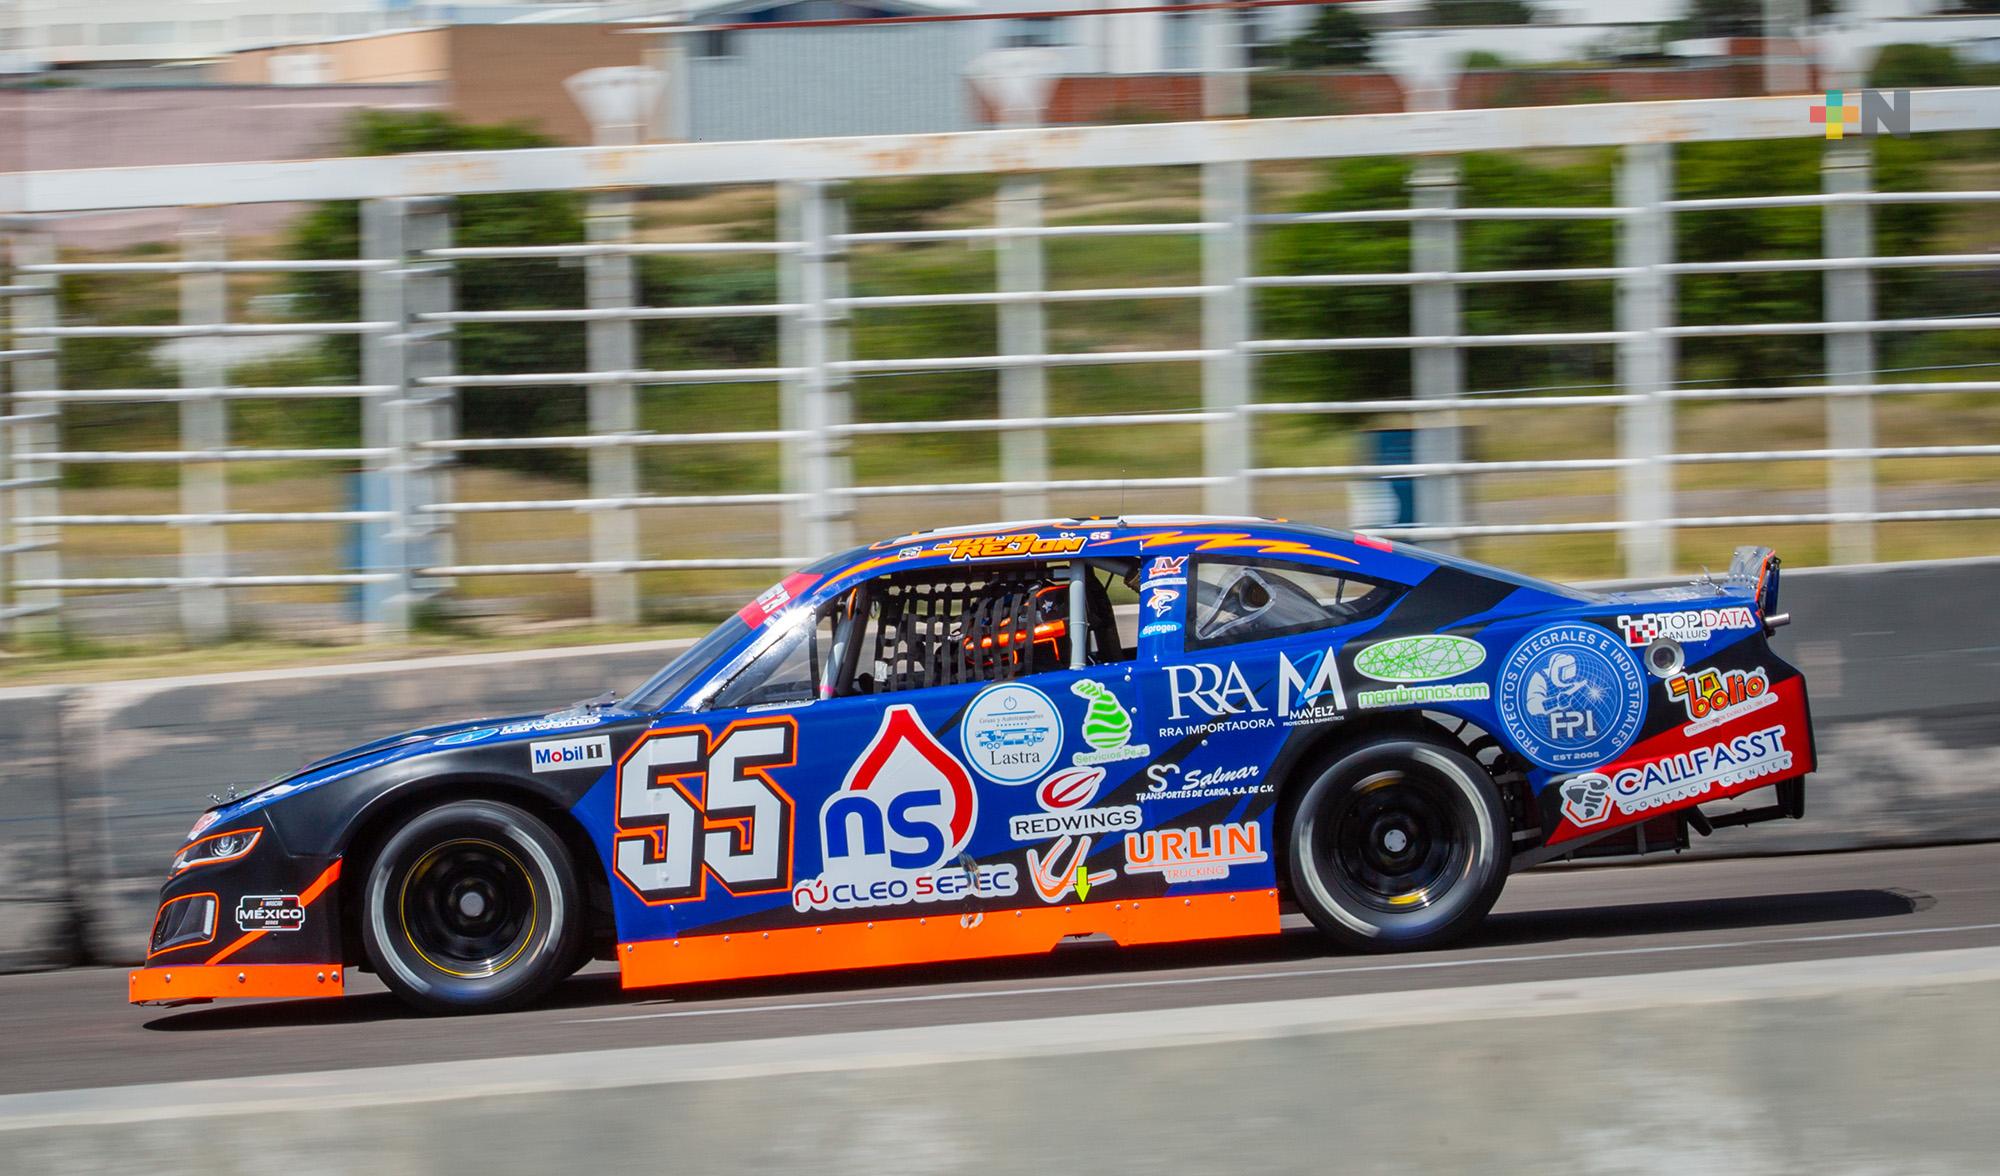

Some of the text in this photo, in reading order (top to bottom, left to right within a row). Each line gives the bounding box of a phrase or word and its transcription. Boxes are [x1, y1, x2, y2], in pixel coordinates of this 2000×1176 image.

[952, 537, 1086, 559] REJON
[1660, 610, 1752, 630] TOP DATA
[1600, 639, 1610, 651] E
[1686, 629, 1708, 639] LUIS
[1513, 631, 1596, 669] INTEGRALES
[1161, 660, 1269, 720] RRA
[1360, 685, 1487, 705] membranas.com
[1610, 648, 1640, 747] INDUSTRIALES
[1687, 672, 1765, 718] bolio
[1289, 705, 1335, 720] MAVELZ
[1503, 673, 1540, 755] PROYECTOS
[1159, 717, 1275, 737] RRA IMPORTADORA
[1550, 710, 1598, 739] FPI
[536, 746, 583, 764] Mobil
[990, 750, 1041, 766] Lastra
[1552, 753, 1573, 762] EST
[1615, 728, 1784, 796] CALLFASST
[1182, 766, 1259, 790] Salmar
[1626, 758, 1790, 812] CONTACT CENTER
[1136, 790, 1191, 802] TRANSPORTES
[1191, 789, 1202, 798] DE
[1248, 785, 1259, 794] DE
[615, 720, 792, 900] 55
[1015, 810, 1137, 835] REDWINGS
[1128, 825, 1256, 863] URLIN
[1167, 865, 1225, 880] TRUCKING
[239, 906, 302, 919] MÉXICO
